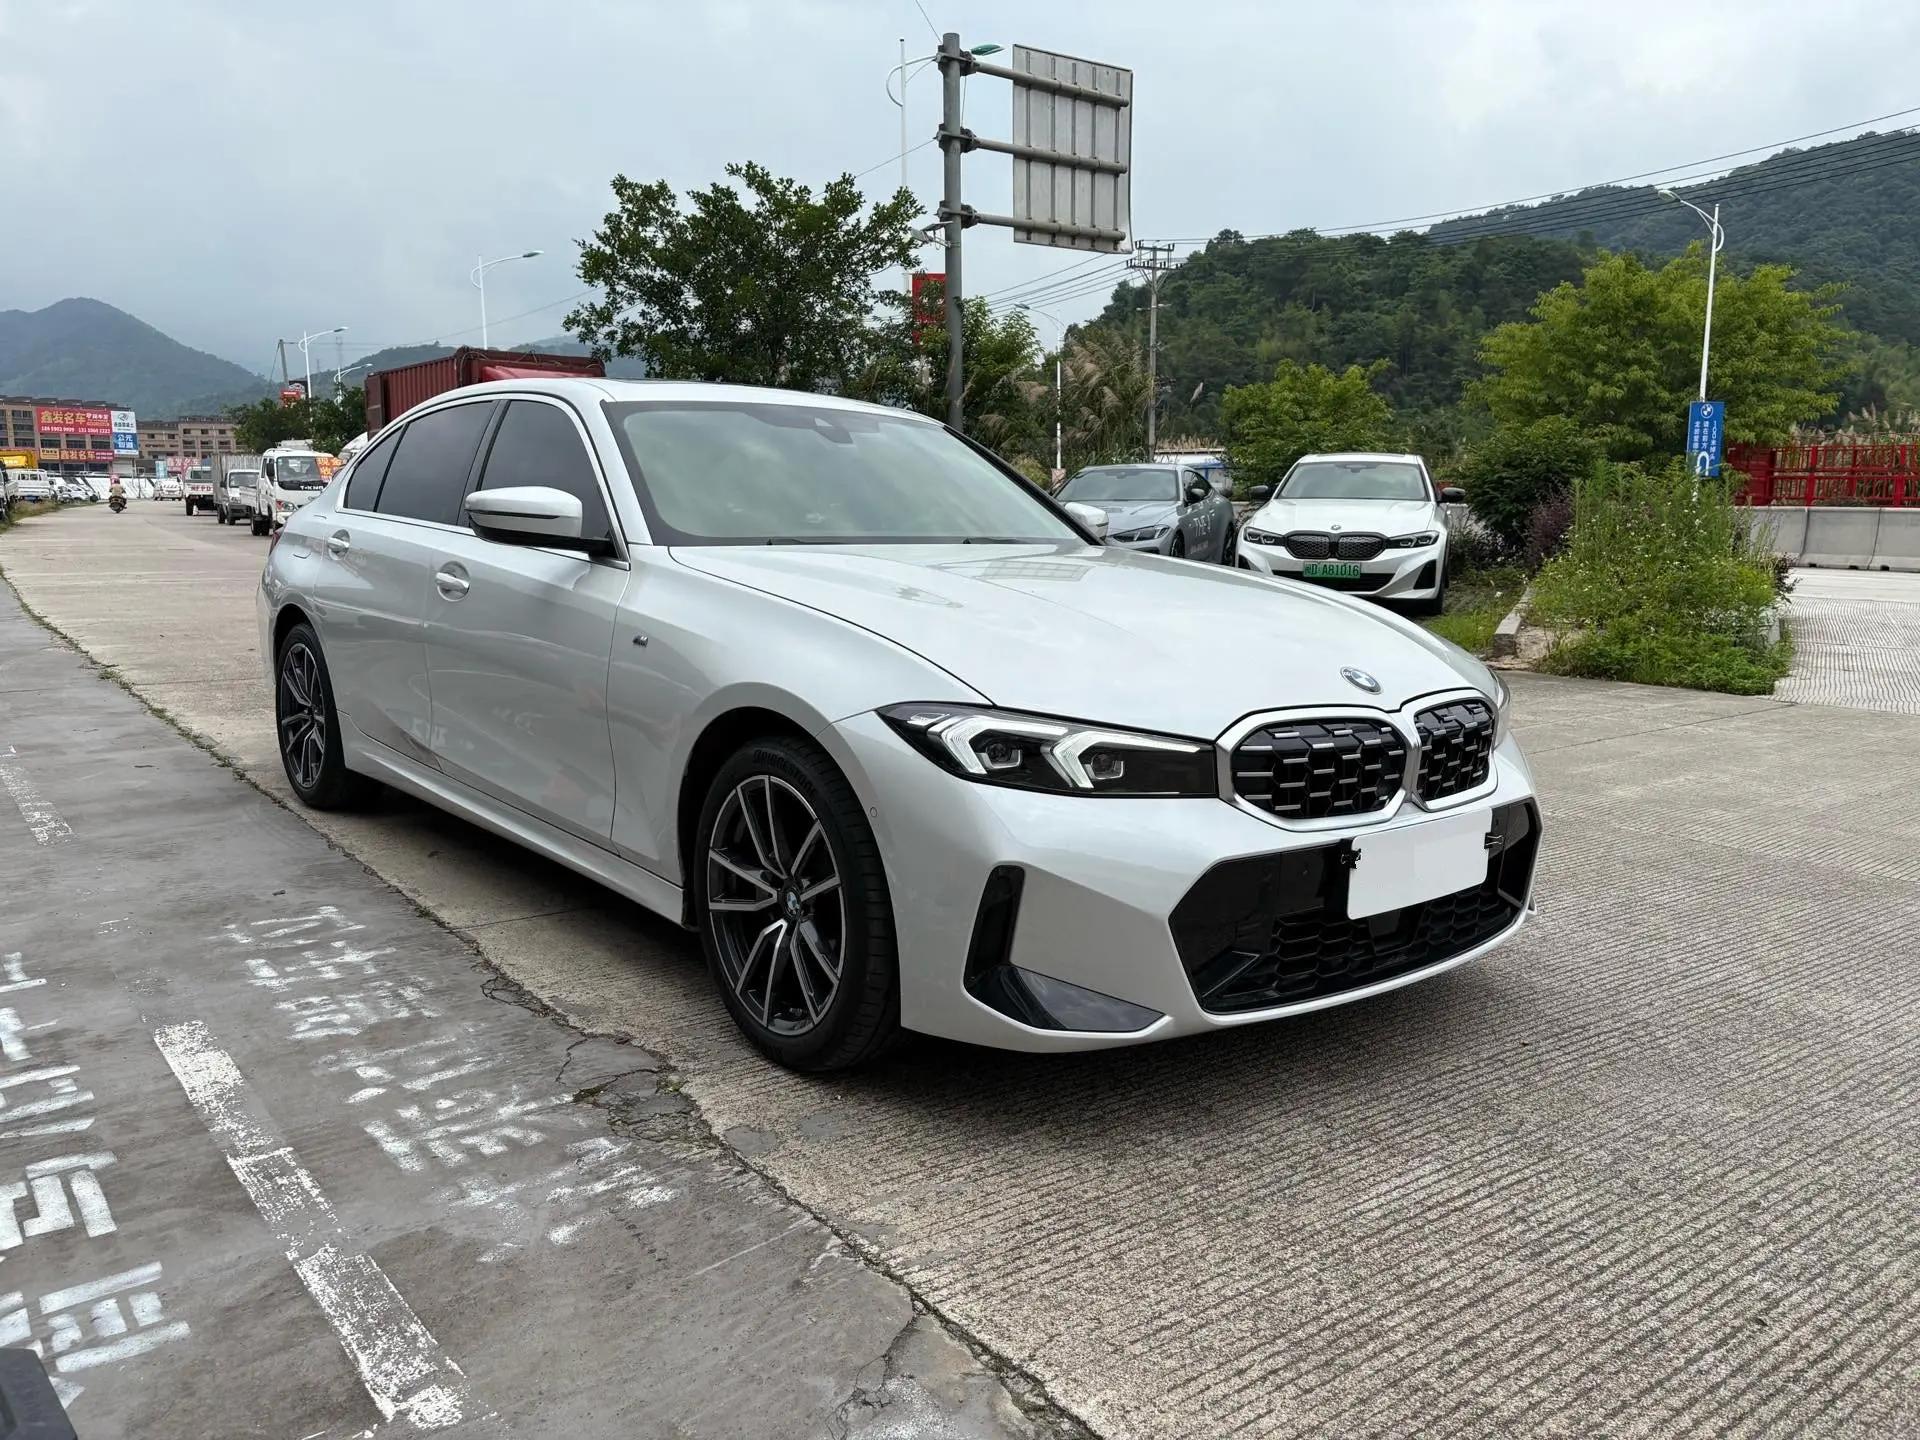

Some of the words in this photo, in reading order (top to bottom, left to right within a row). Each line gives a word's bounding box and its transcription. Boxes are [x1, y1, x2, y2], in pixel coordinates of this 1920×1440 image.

[41, 410, 86, 425] 鑫发名车
[60, 450, 95, 460] 鑫发名车
[752, 749, 817, 796] BRIDGESTONE
